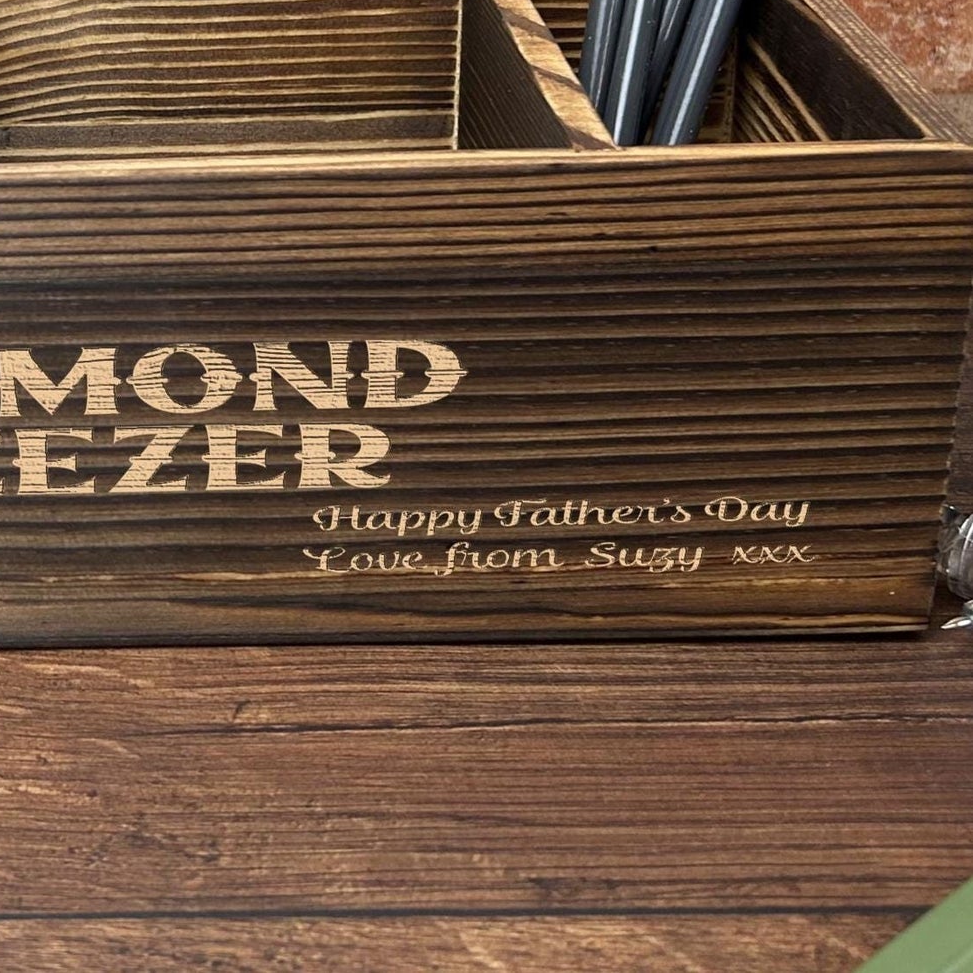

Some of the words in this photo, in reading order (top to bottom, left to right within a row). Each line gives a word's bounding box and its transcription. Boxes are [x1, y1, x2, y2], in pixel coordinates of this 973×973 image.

[312, 504, 482, 536] Happy
[494, 497, 691, 526] Father's
[704, 496, 810, 527] Day
[303, 546, 424, 573] Love
[434, 541, 565, 576] from
[584, 542, 704, 573] Suzy
[731, 544, 815, 565] xxx
